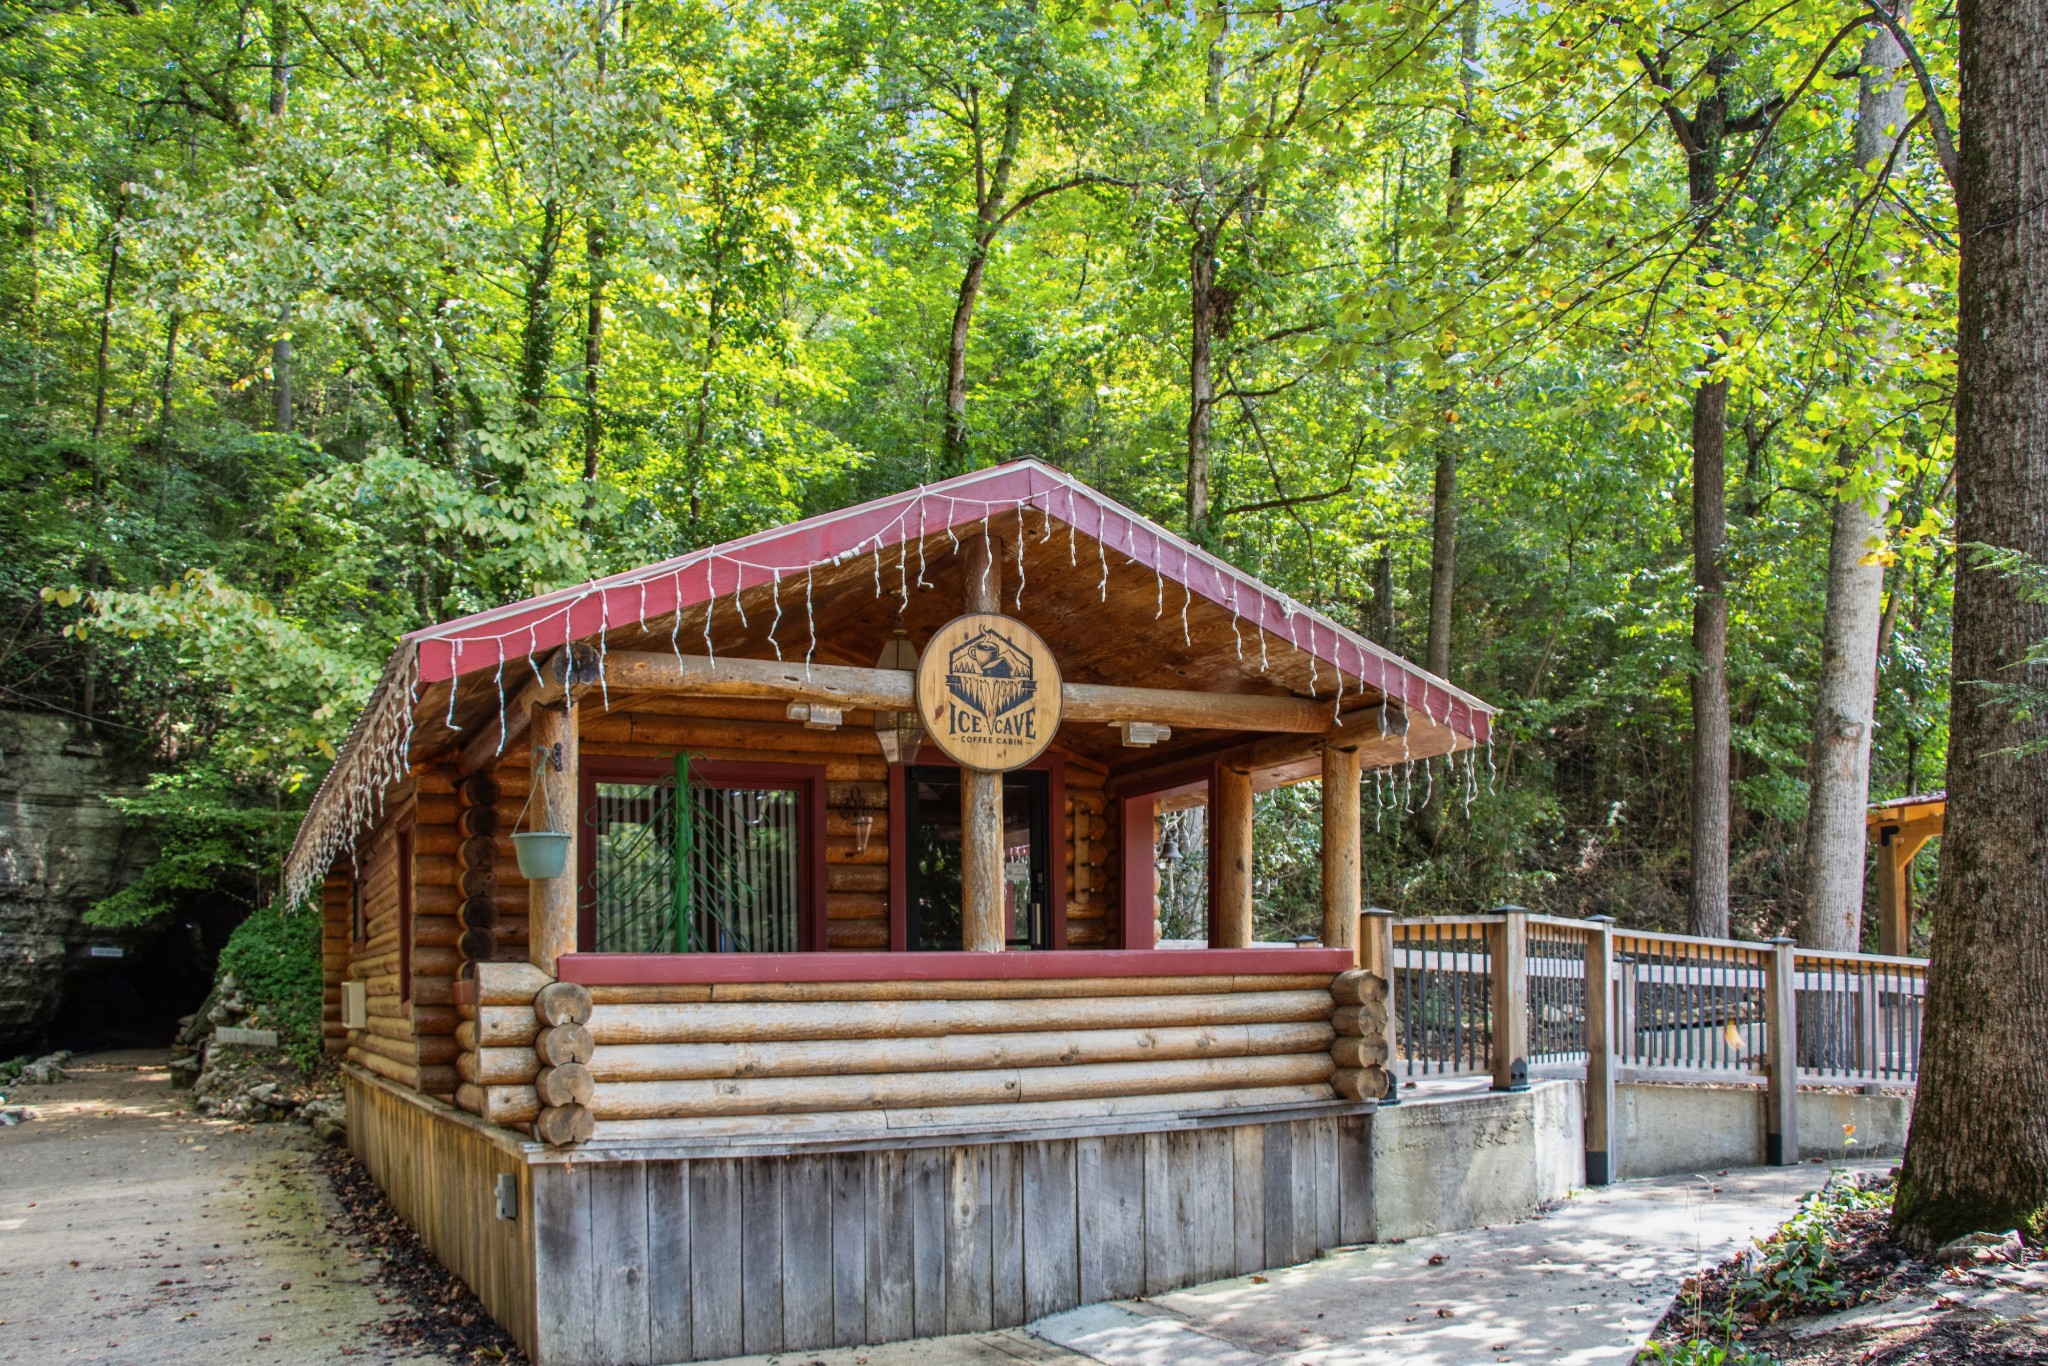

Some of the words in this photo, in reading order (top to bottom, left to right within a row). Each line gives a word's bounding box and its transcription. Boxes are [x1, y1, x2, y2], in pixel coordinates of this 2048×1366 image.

[949, 701, 982, 735] ICE
[995, 706, 1036, 740] CAVE
[961, 736, 993, 744] COFFEE
[996, 737, 1023, 746] CABIN
